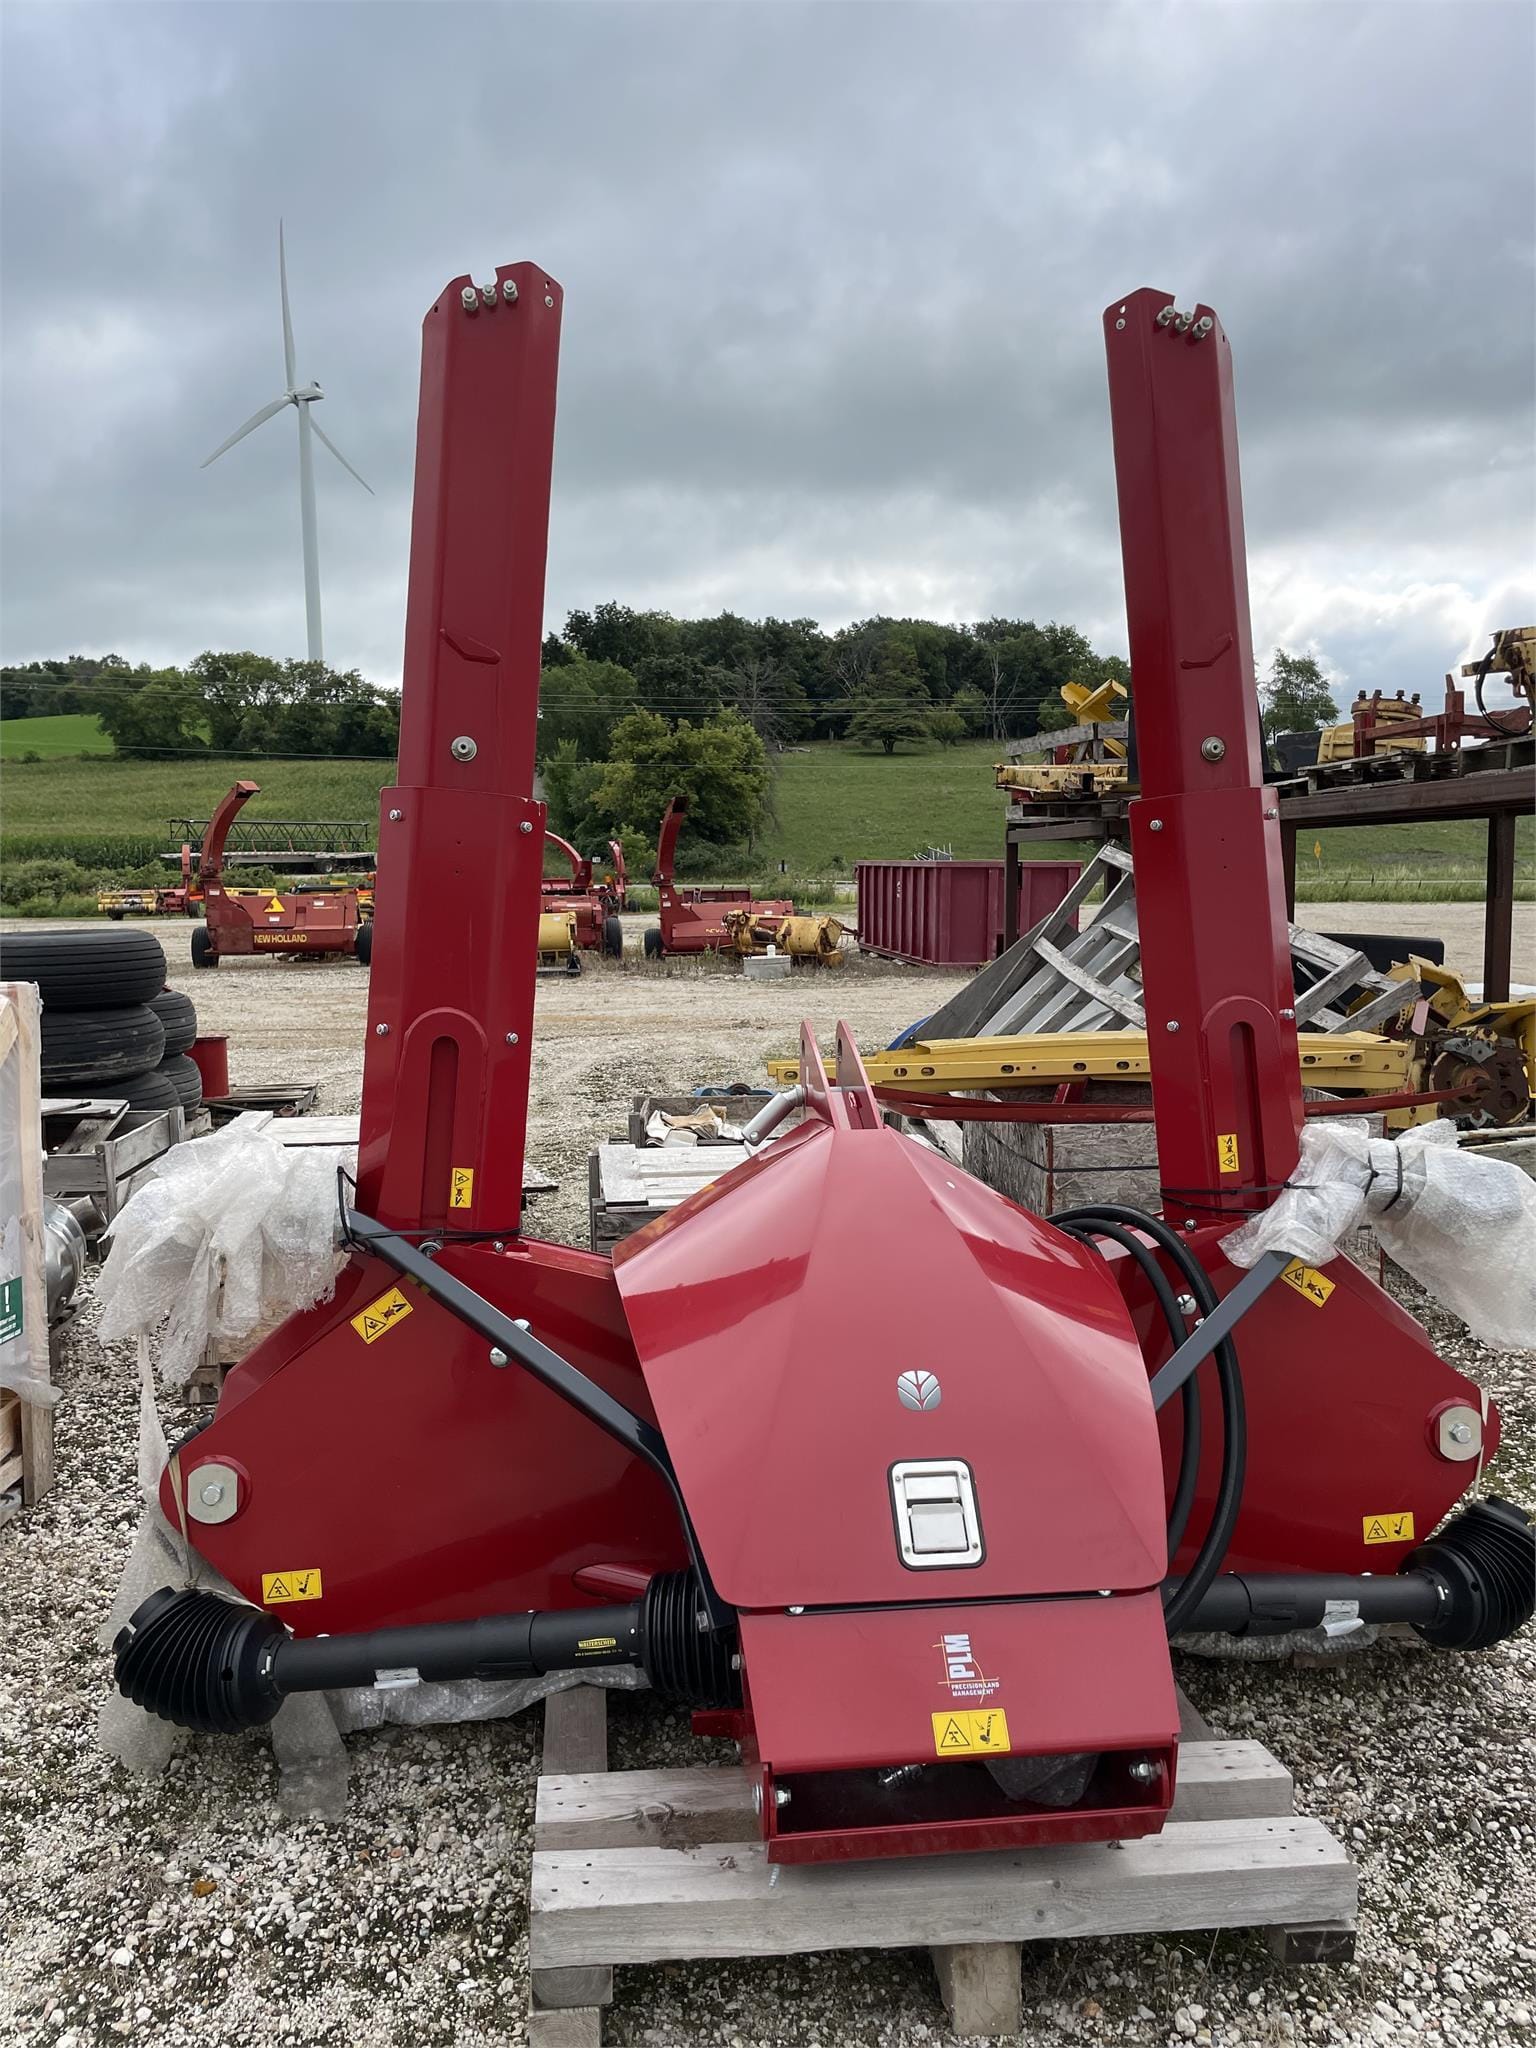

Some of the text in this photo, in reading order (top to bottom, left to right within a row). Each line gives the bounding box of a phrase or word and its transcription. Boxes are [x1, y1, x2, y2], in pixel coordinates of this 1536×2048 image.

[254, 934, 308, 943] NEW HOLLAND
[944, 1634, 975, 1678] PLM
[952, 1689, 994, 1697] MANAGEMENT
